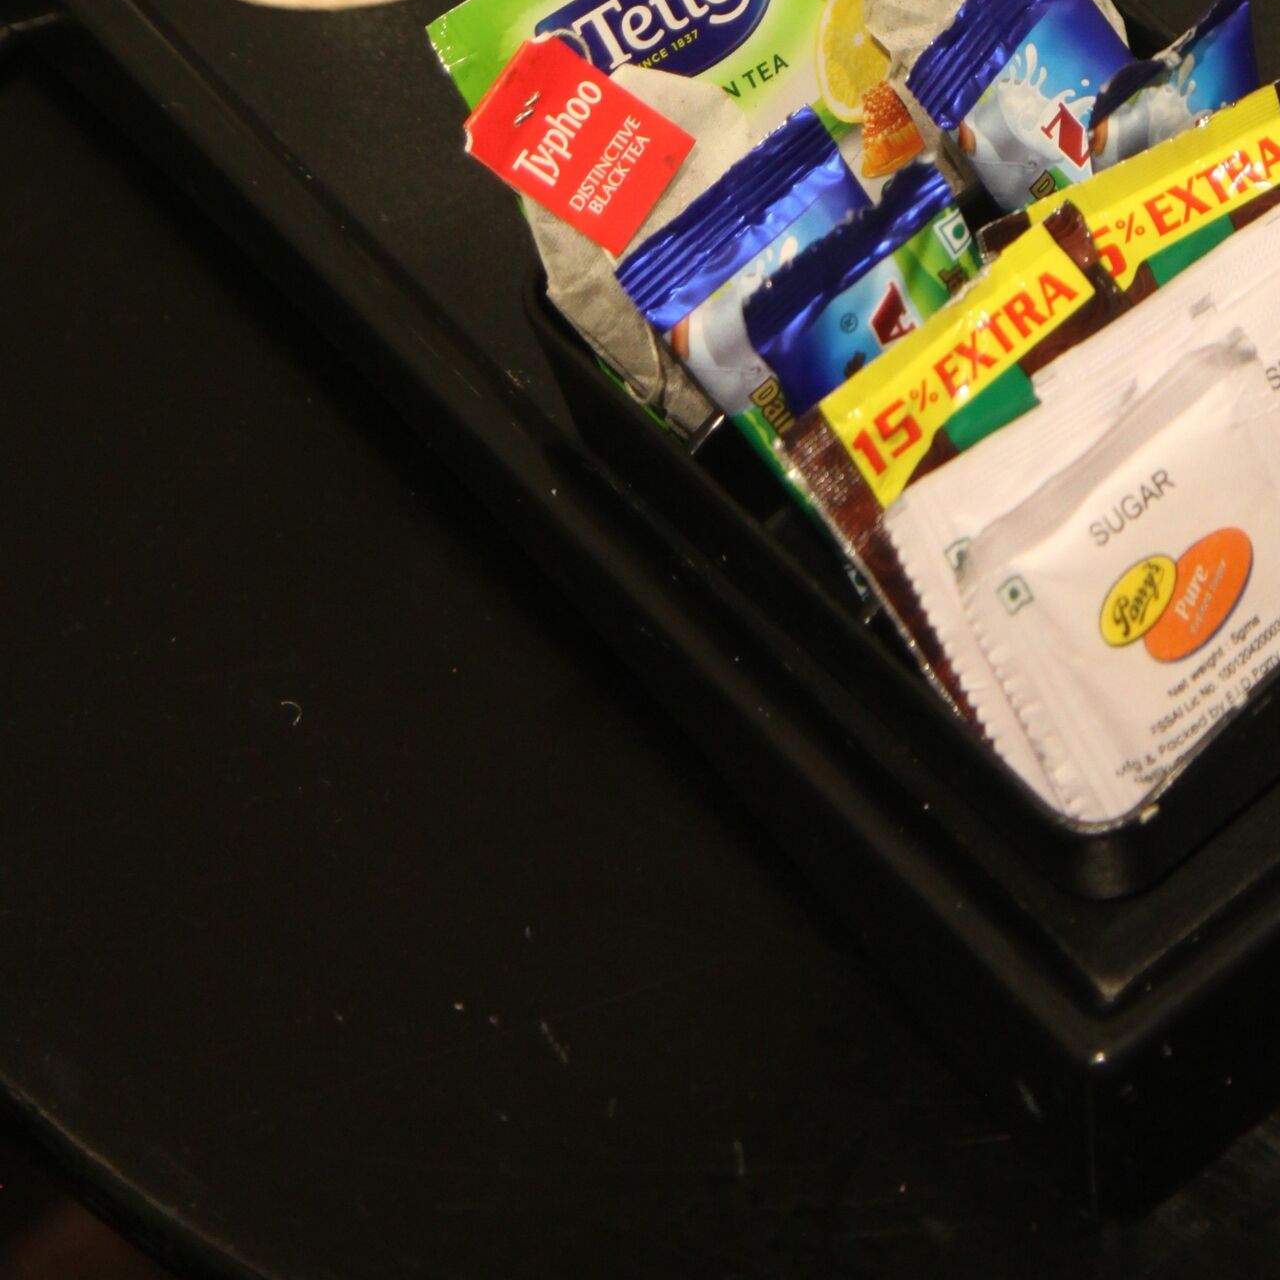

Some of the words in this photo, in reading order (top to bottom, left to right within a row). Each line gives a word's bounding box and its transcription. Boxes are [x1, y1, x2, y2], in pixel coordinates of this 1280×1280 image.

[671, 29, 699, 52] 1837
[742, 54, 789, 90] TEA
[568, 115, 641, 213] DISTINCTIVE
[587, 162, 631, 217] BLACK
[622, 134, 651, 171] TEA
[852, 378, 938, 477] 15%
[933, 271, 1080, 400] EXTRA
[1089, 467, 1177, 548] SUGAR
[1174, 562, 1210, 621] Pure
